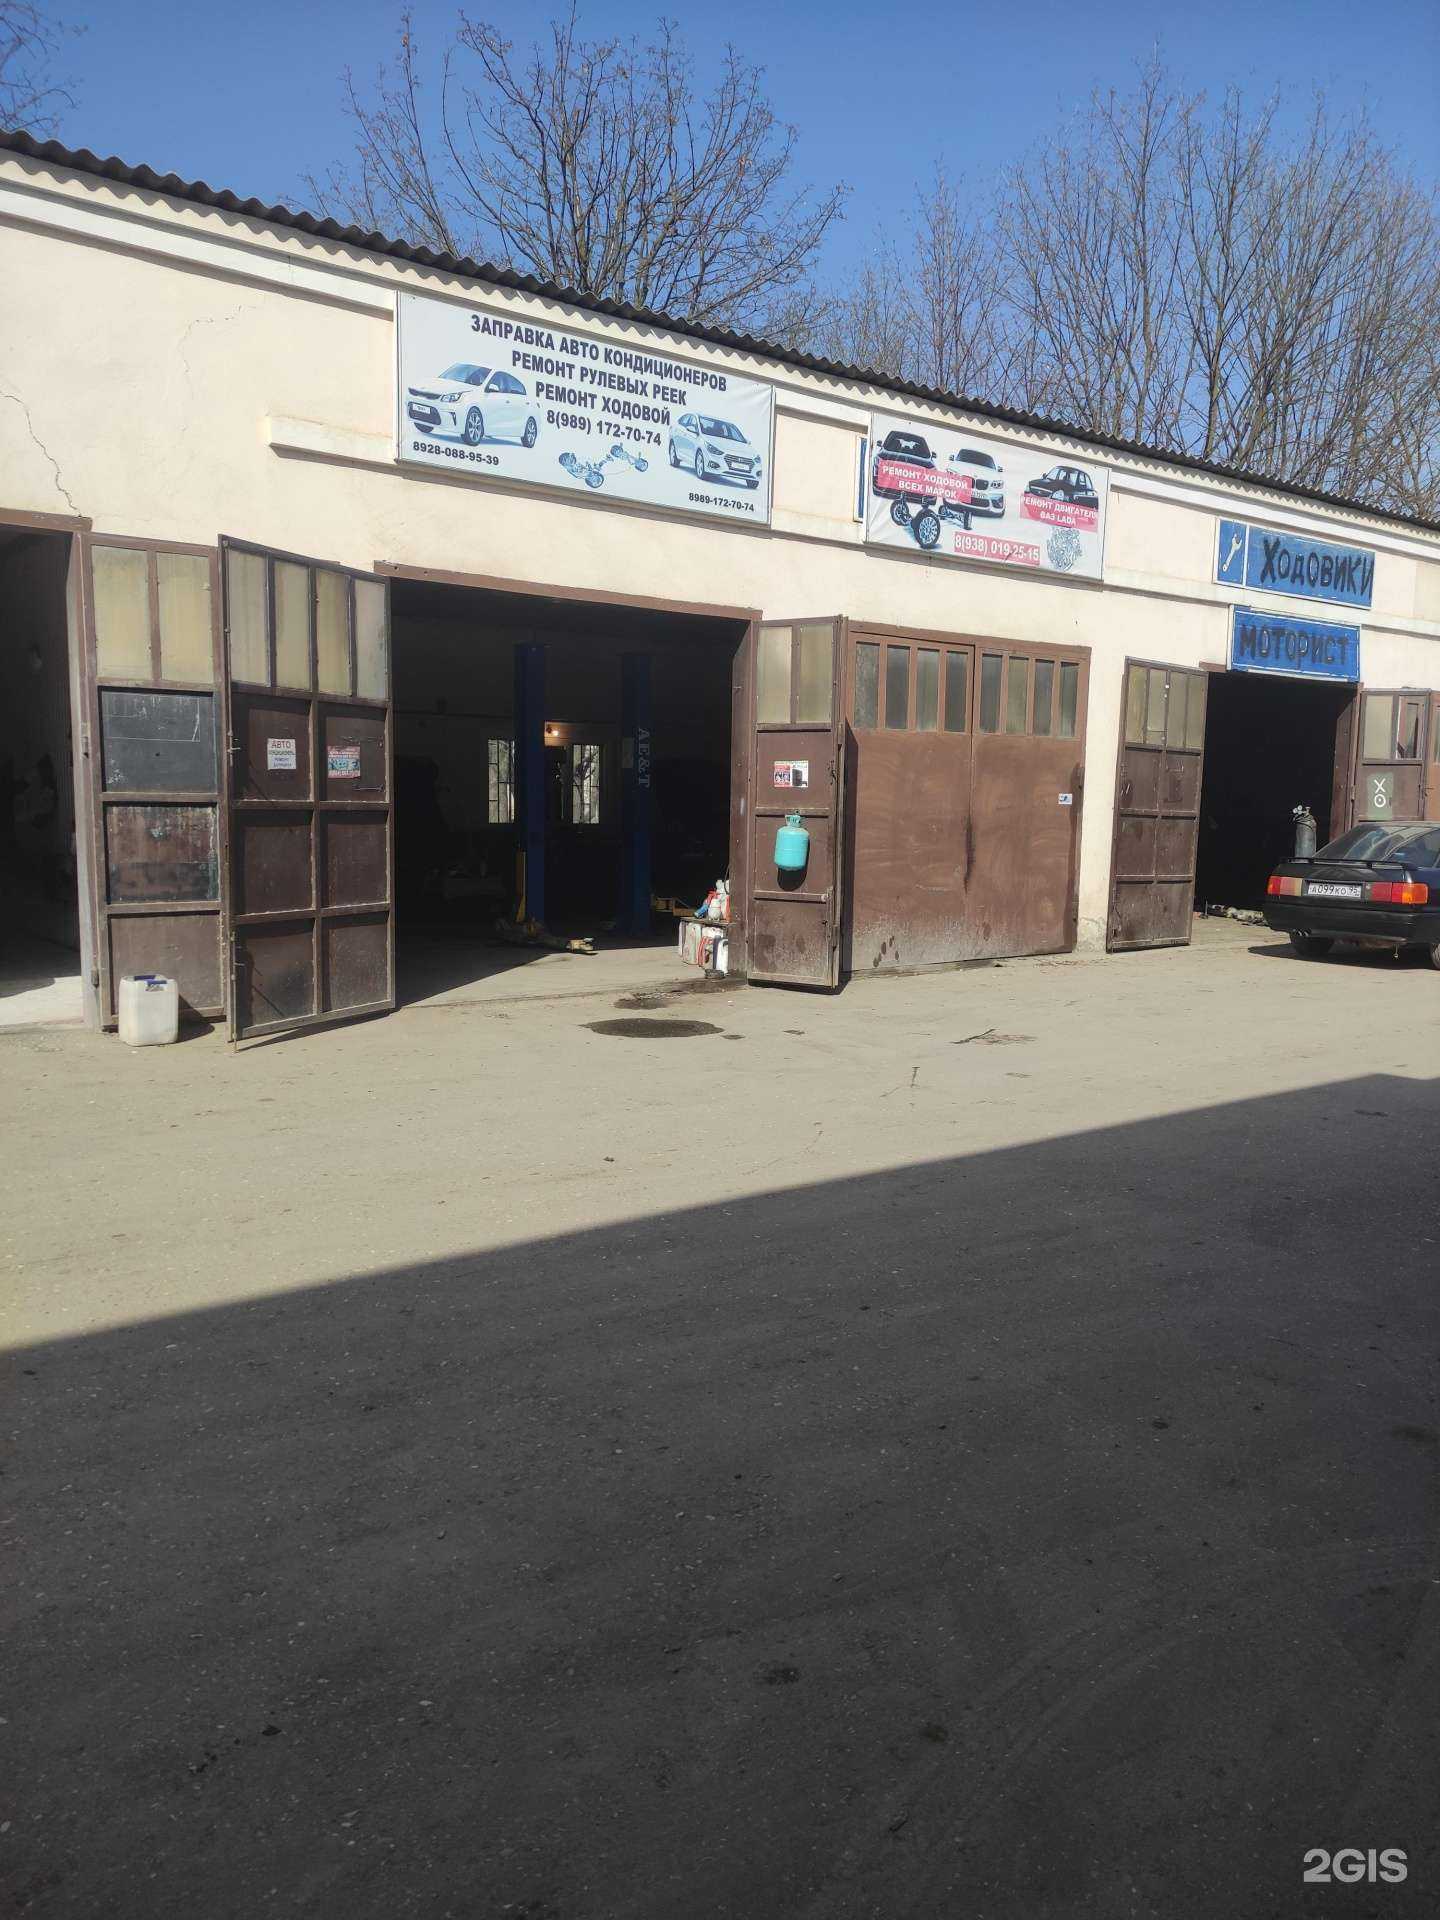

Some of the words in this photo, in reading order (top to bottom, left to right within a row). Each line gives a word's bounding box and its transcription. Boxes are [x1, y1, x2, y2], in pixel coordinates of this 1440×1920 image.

[471, 314, 555, 351] ЗАПРАВКА
[559, 336, 600, 361] АВТО
[604, 348, 728, 393] КОНДИЦИОНЕРОВ
[512, 350, 576, 380] РЕМОНТ
[580, 365, 649, 398] РУЛЕВЫХ
[652, 384, 687, 406] РЕЕК
[535, 381, 598, 410] РЕМОНТ
[601, 395, 671, 427] ХОДОВОЙ
[546, 409, 592, 435] 8(989)
[596, 420, 662, 446] 172-70-74
[413, 441, 499, 466] 8928-088-95-39
[882, 465, 921, 480] РЕМОНТ
[898, 480, 923, 491] ВСЕХ
[925, 485, 957, 499] МАРОК
[688, 492, 755, 512] 8989-172-70-74
[955, 534, 987, 554] 8(938)
[991, 541, 1039, 560] 019-25-15
[1239, 624, 1349, 668] МОТОРИСТ
[638, 727, 650, 788] AE&T
